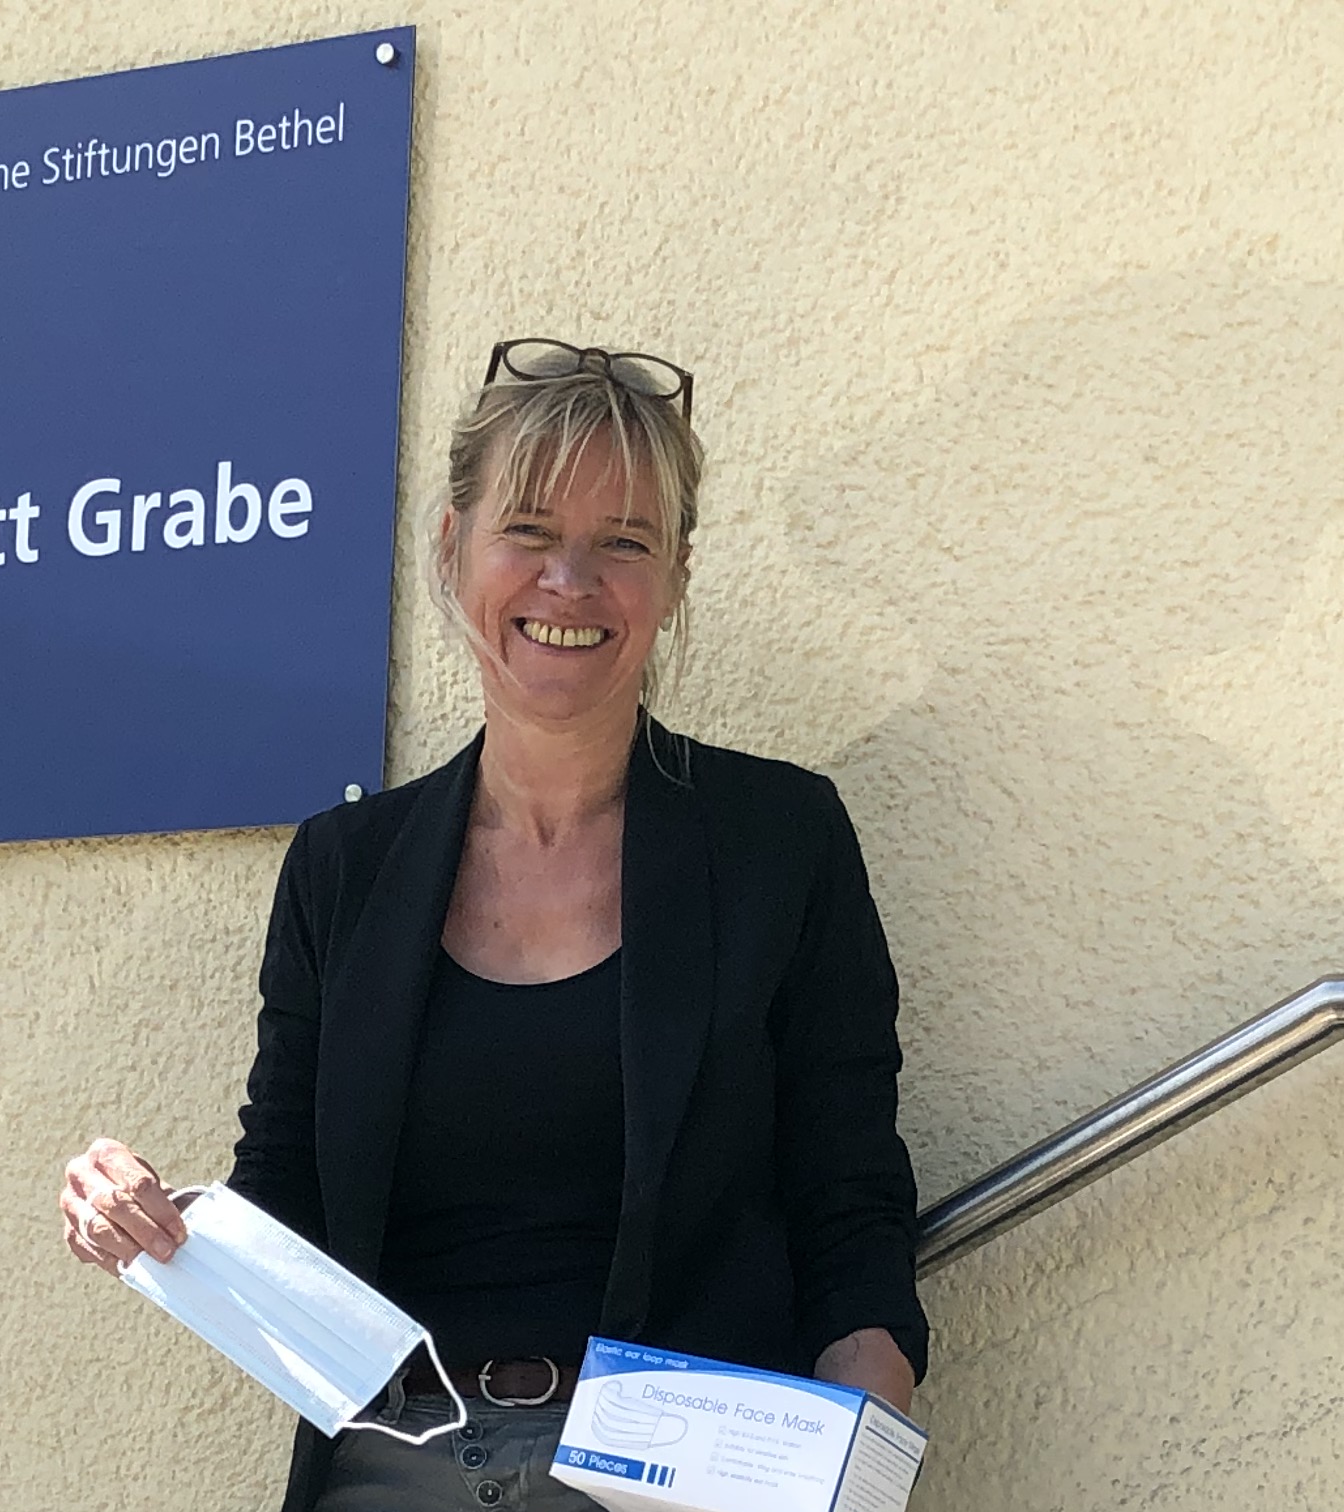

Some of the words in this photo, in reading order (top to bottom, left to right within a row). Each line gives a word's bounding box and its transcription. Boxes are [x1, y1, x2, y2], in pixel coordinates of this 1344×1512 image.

[42, 132, 220, 185] Stiftungen
[235, 102, 345, 156] Bethel
[67, 461, 313, 557] Grabe
[641, 1383, 729, 1416] Disposable
[732, 1402, 776, 1426] Face
[780, 1412, 826, 1436] Mask
[566, 1449, 587, 1466] 50
[586, 1453, 629, 1475] Pieces
